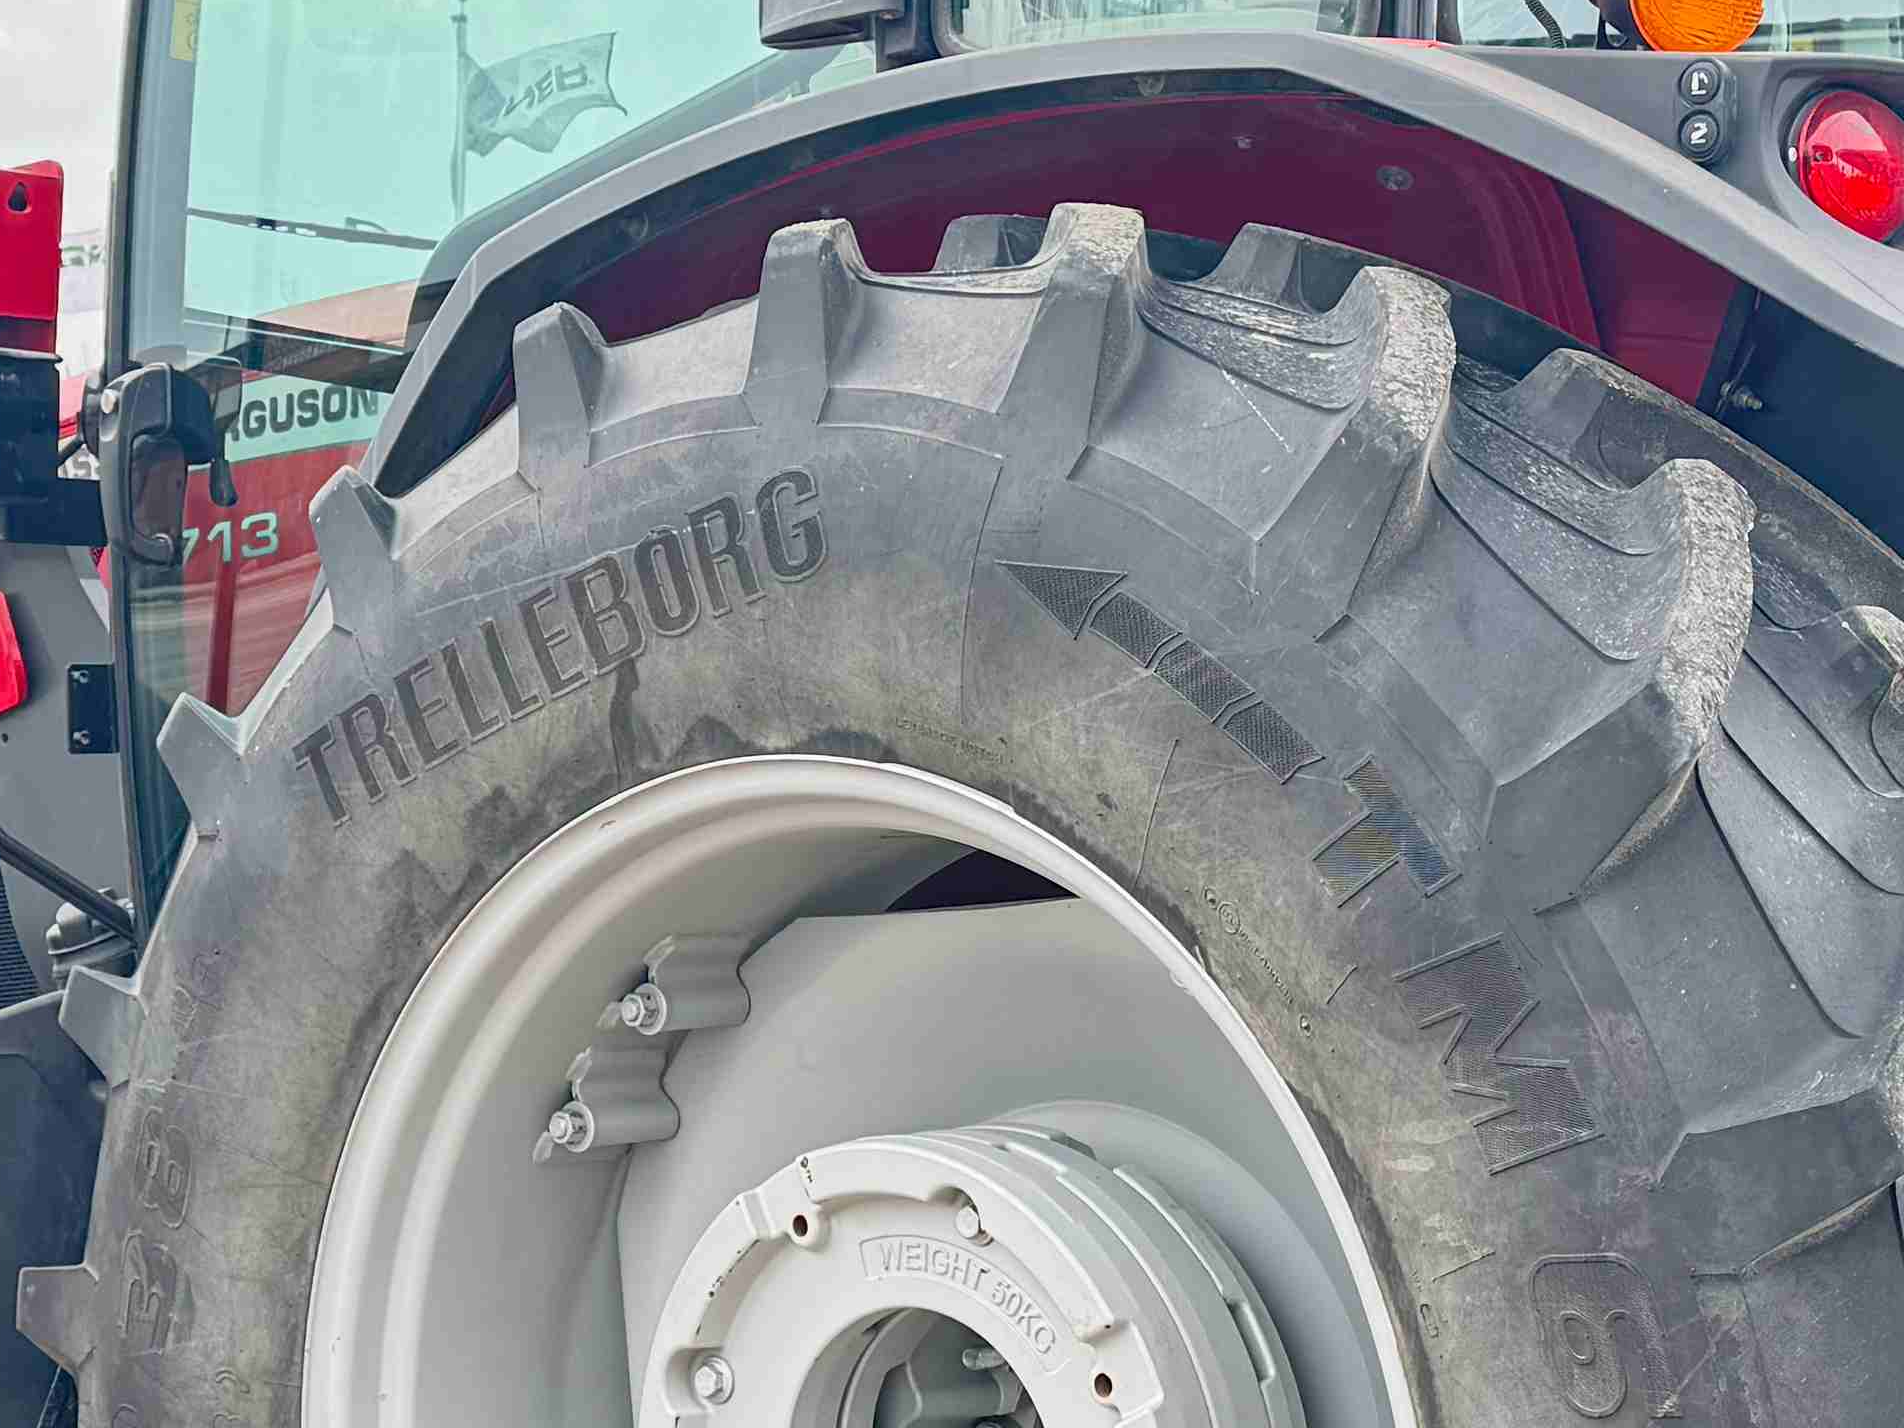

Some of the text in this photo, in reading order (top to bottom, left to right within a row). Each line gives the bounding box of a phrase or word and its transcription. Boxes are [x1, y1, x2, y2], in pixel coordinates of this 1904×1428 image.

[292, 464, 830, 828] TRELLEBORG
[878, 1239, 1059, 1356] WEIGHT 50KG
